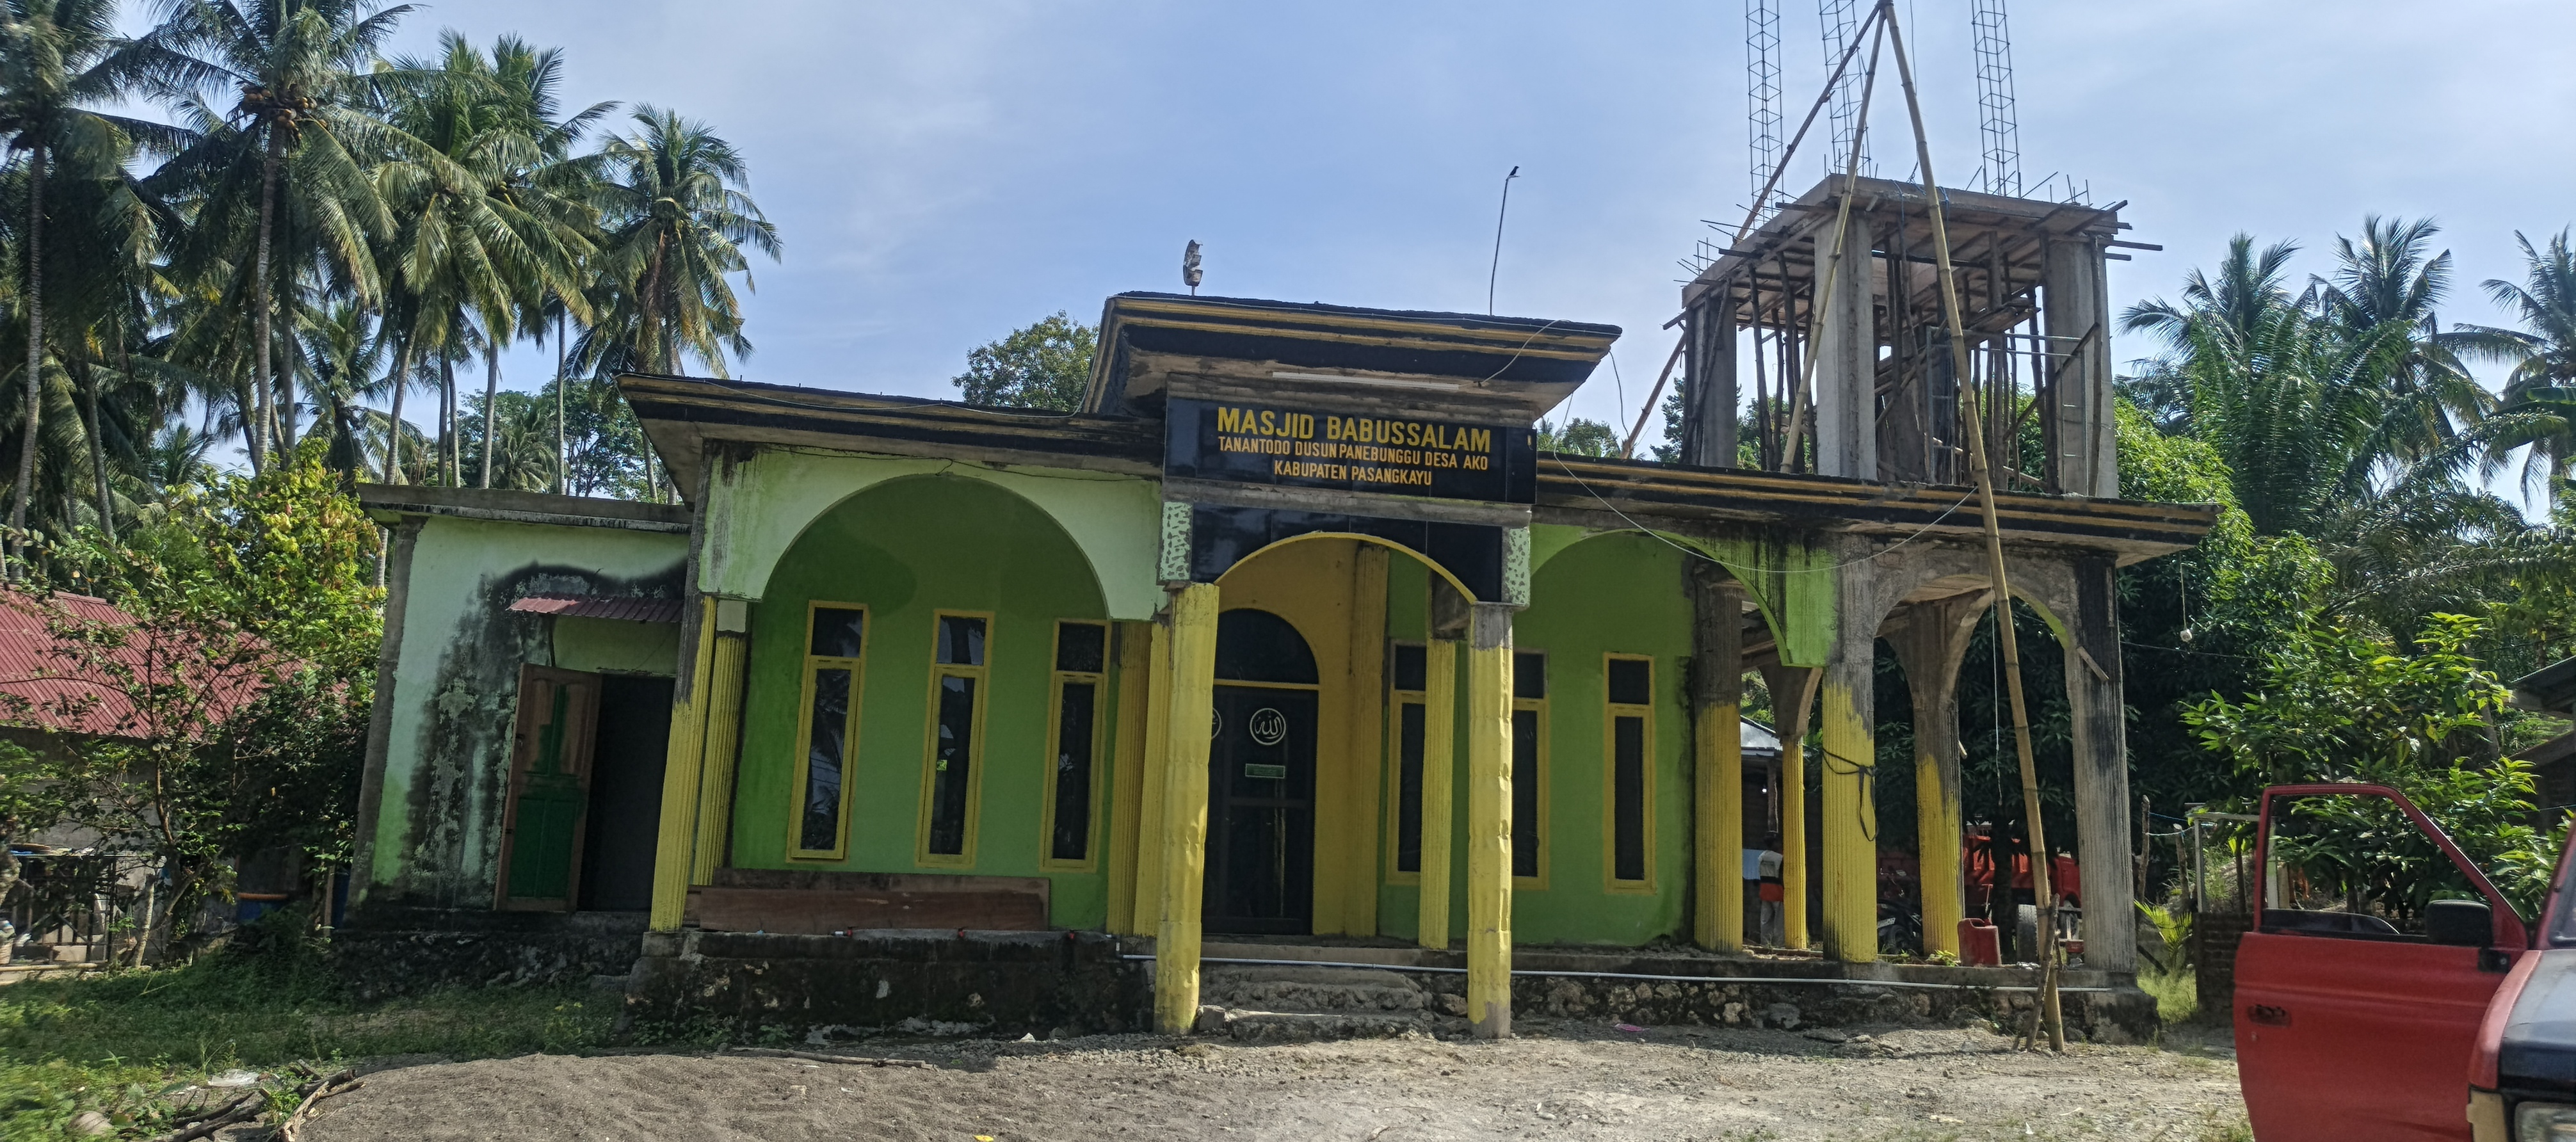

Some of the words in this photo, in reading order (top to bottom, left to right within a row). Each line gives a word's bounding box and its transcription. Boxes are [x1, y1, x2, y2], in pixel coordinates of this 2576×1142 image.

[1218, 406, 1314, 439] MASJID
[1327, 416, 1490, 452] BABUSSALAM
[1219, 436, 1290, 454] TANANTODO
[1295, 441, 1337, 457] DUSUN
[1339, 444, 1421, 465] PANEBUNGGU
[1424, 451, 1457, 467] DESA
[1463, 455, 1488, 470] AKO
[1275, 460, 1347, 479] KABUPATEN
[1351, 466, 1432, 485] PASANGKAYU
